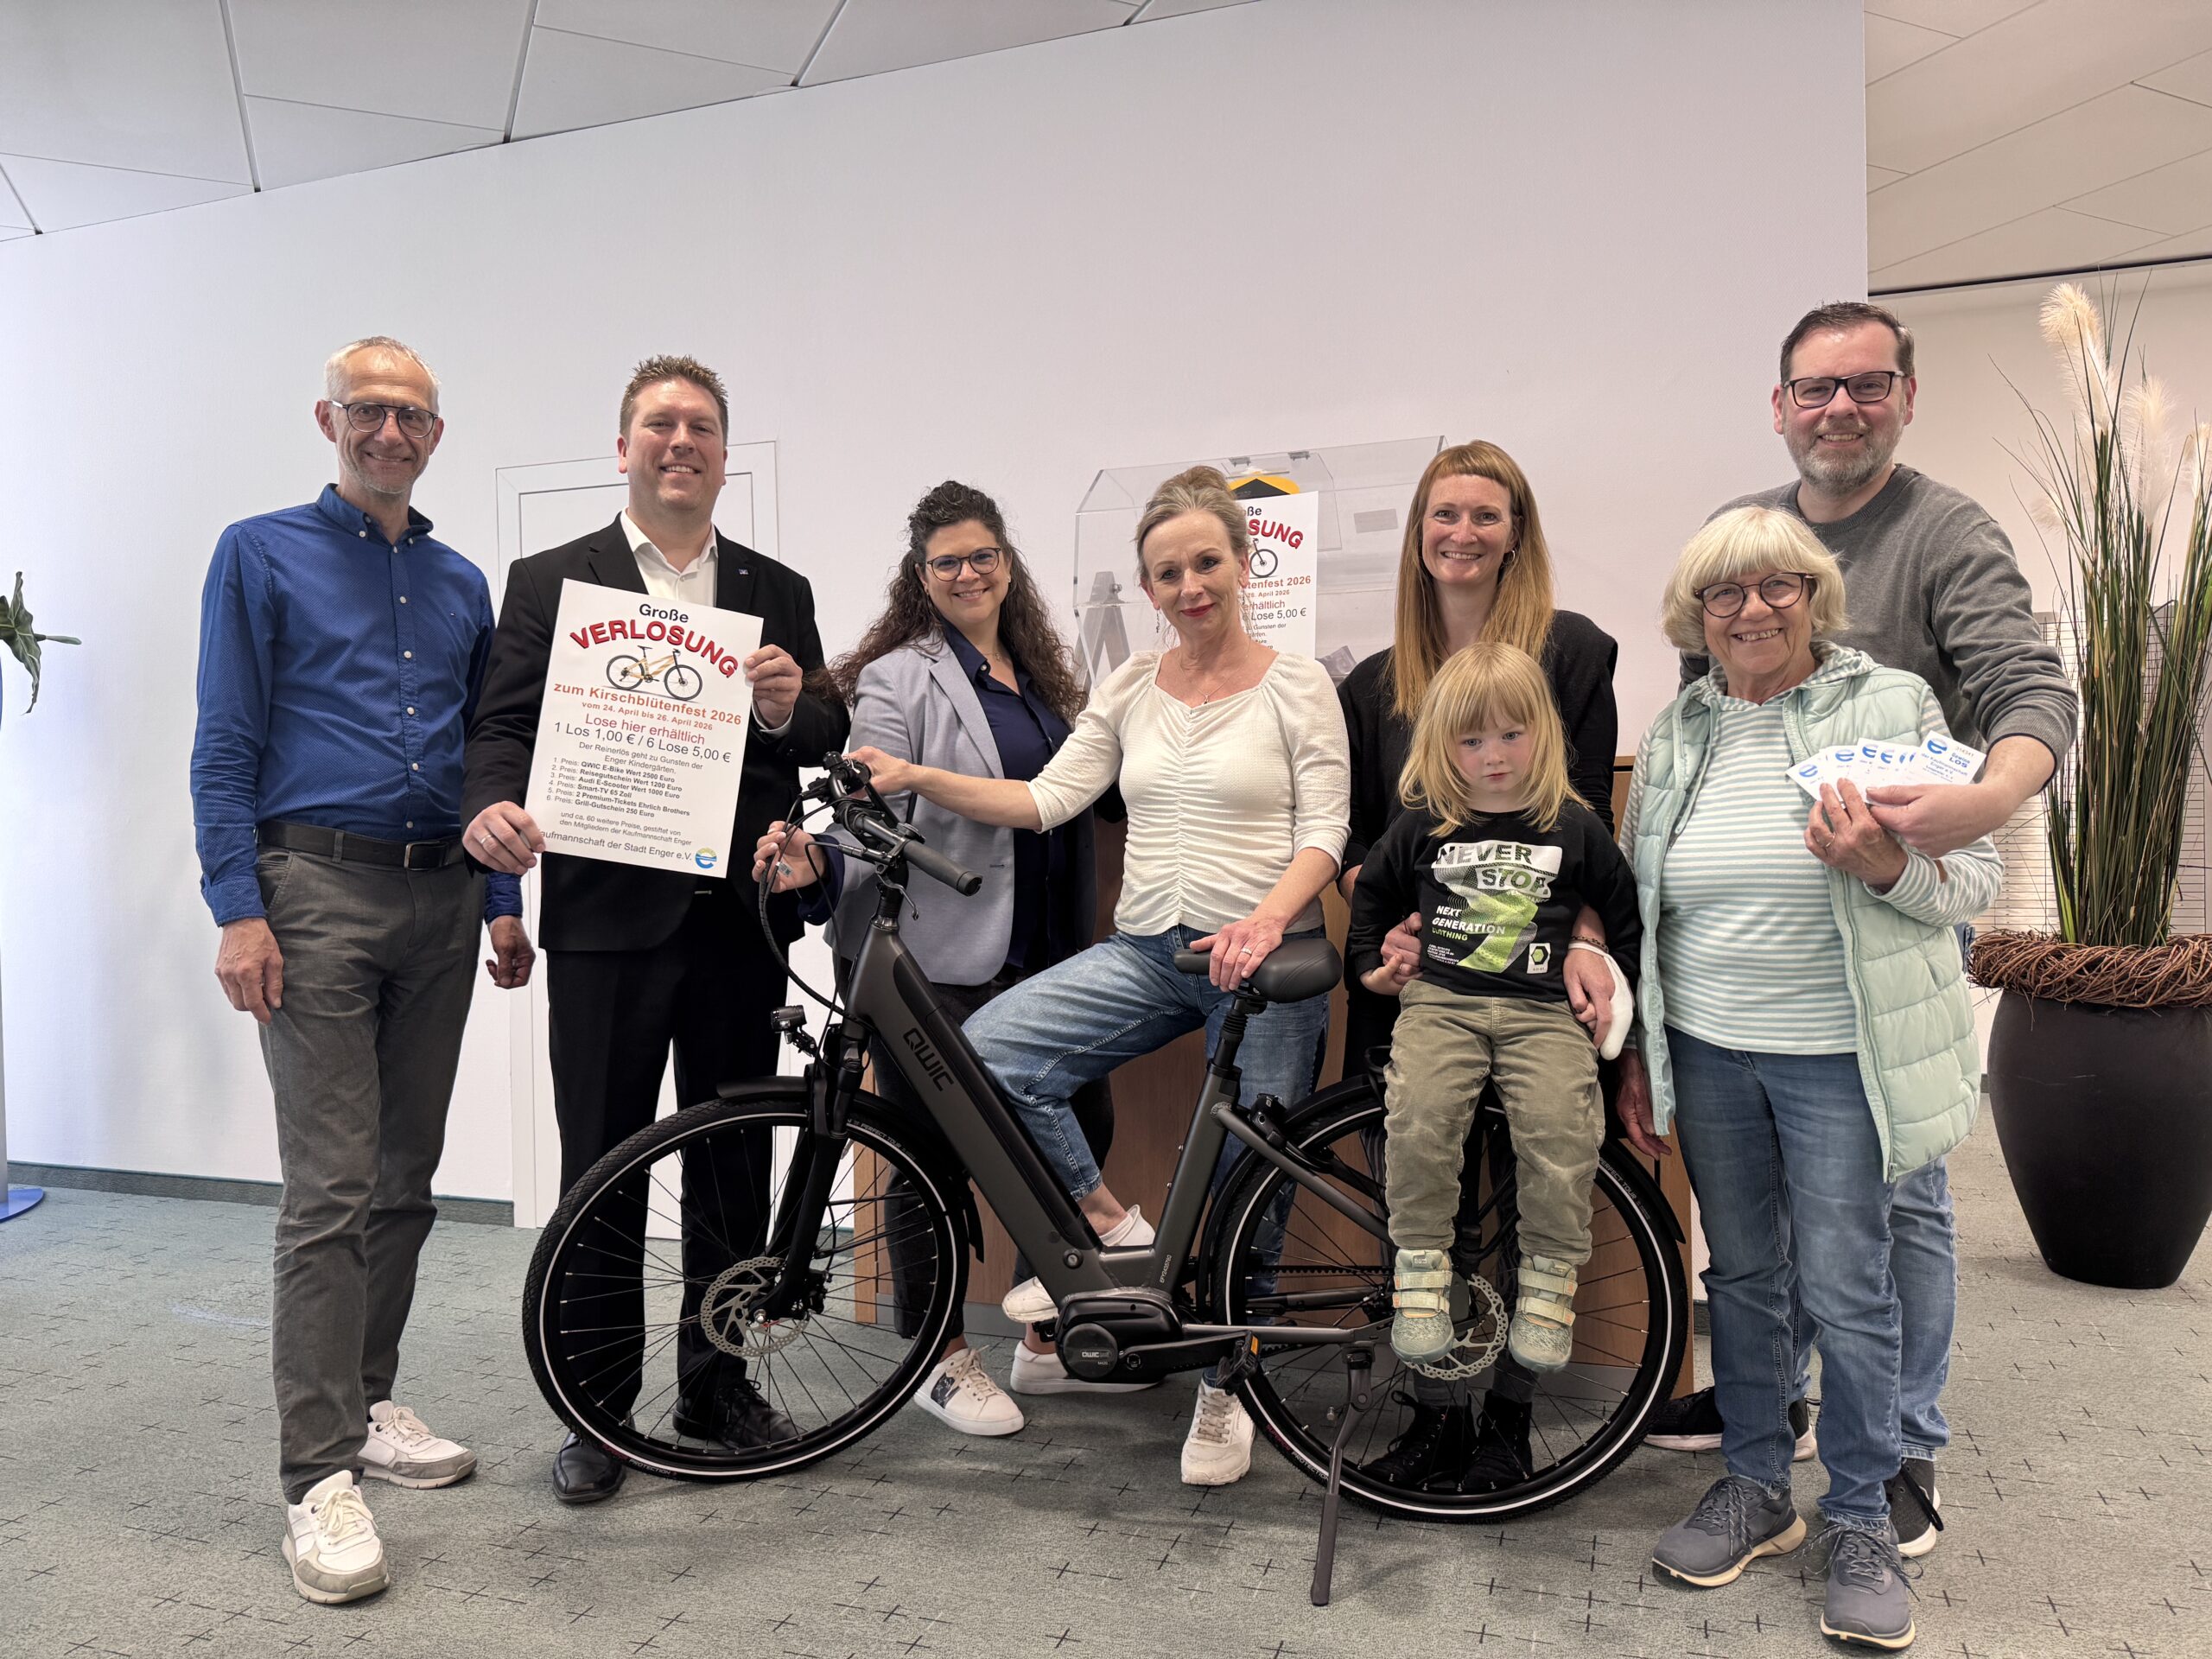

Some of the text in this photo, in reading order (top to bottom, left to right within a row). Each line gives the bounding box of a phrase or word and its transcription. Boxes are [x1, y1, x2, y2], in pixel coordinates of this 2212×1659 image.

[1287, 575, 1311, 586] 2026
[639, 603, 689, 623] Große
[1250, 607, 1306, 621] Lose 5,00 €
[570, 620, 738, 677] VERLOSUNG
[553, 683, 741, 725] zum Kirschblütenfest 2026
[602, 703, 615, 712] 24.
[617, 707, 639, 716] April
[641, 710, 654, 719] bis
[656, 713, 669, 721] 26.
[671, 716, 691, 726] April
[693, 721, 712, 730] 2026
[585, 713, 705, 745] Lose hier erhältlich
[555, 721, 731, 763] 1 Los 1,00 € / 6 Lose 5,00 €
[578, 741, 594, 750] Der
[594, 743, 629, 756] Reinerlös
[659, 755, 690, 767] Gunsten
[604, 754, 676, 774] Enger Kindergärten.
[1948, 757, 1967, 768] LOS
[579, 768, 632, 783] Reisegutschein
[650, 780, 665, 789] 1200
[666, 783, 683, 791] Euro
[581, 760, 601, 769] QWIC
[601, 764, 624, 773] E-Bike
[626, 768, 641, 777] Wert
[658, 774, 675, 783] Euro
[577, 783, 608, 794] Smart-TV
[619, 790, 632, 798] Zoll
[595, 779, 629, 790] E-Scooter
[631, 785, 646, 793] Wert
[664, 791, 680, 799] Euro
[575, 798, 625, 812] Grill-Gutschein
[639, 809, 655, 817] Euro
[582, 791, 637, 807] Premium-Tickets
[638, 801, 661, 810] Ehrlich
[662, 805, 690, 816] Brothers
[539, 830, 605, 847] aufmannschaft
[607, 840, 622, 849] der
[623, 842, 646, 854] Stadt
[648, 846, 674, 858] Enger
[622, 829, 672, 842] Kaufmannschaft
[673, 836, 691, 846] Enger
[1435, 843, 1532, 865] NEVER
[1436, 905, 1462, 917] NEXT
[1432, 917, 1506, 935] GENERATION
[902, 1027, 955, 1092] QWIC
[861, 1122, 887, 1138] PERFECT
